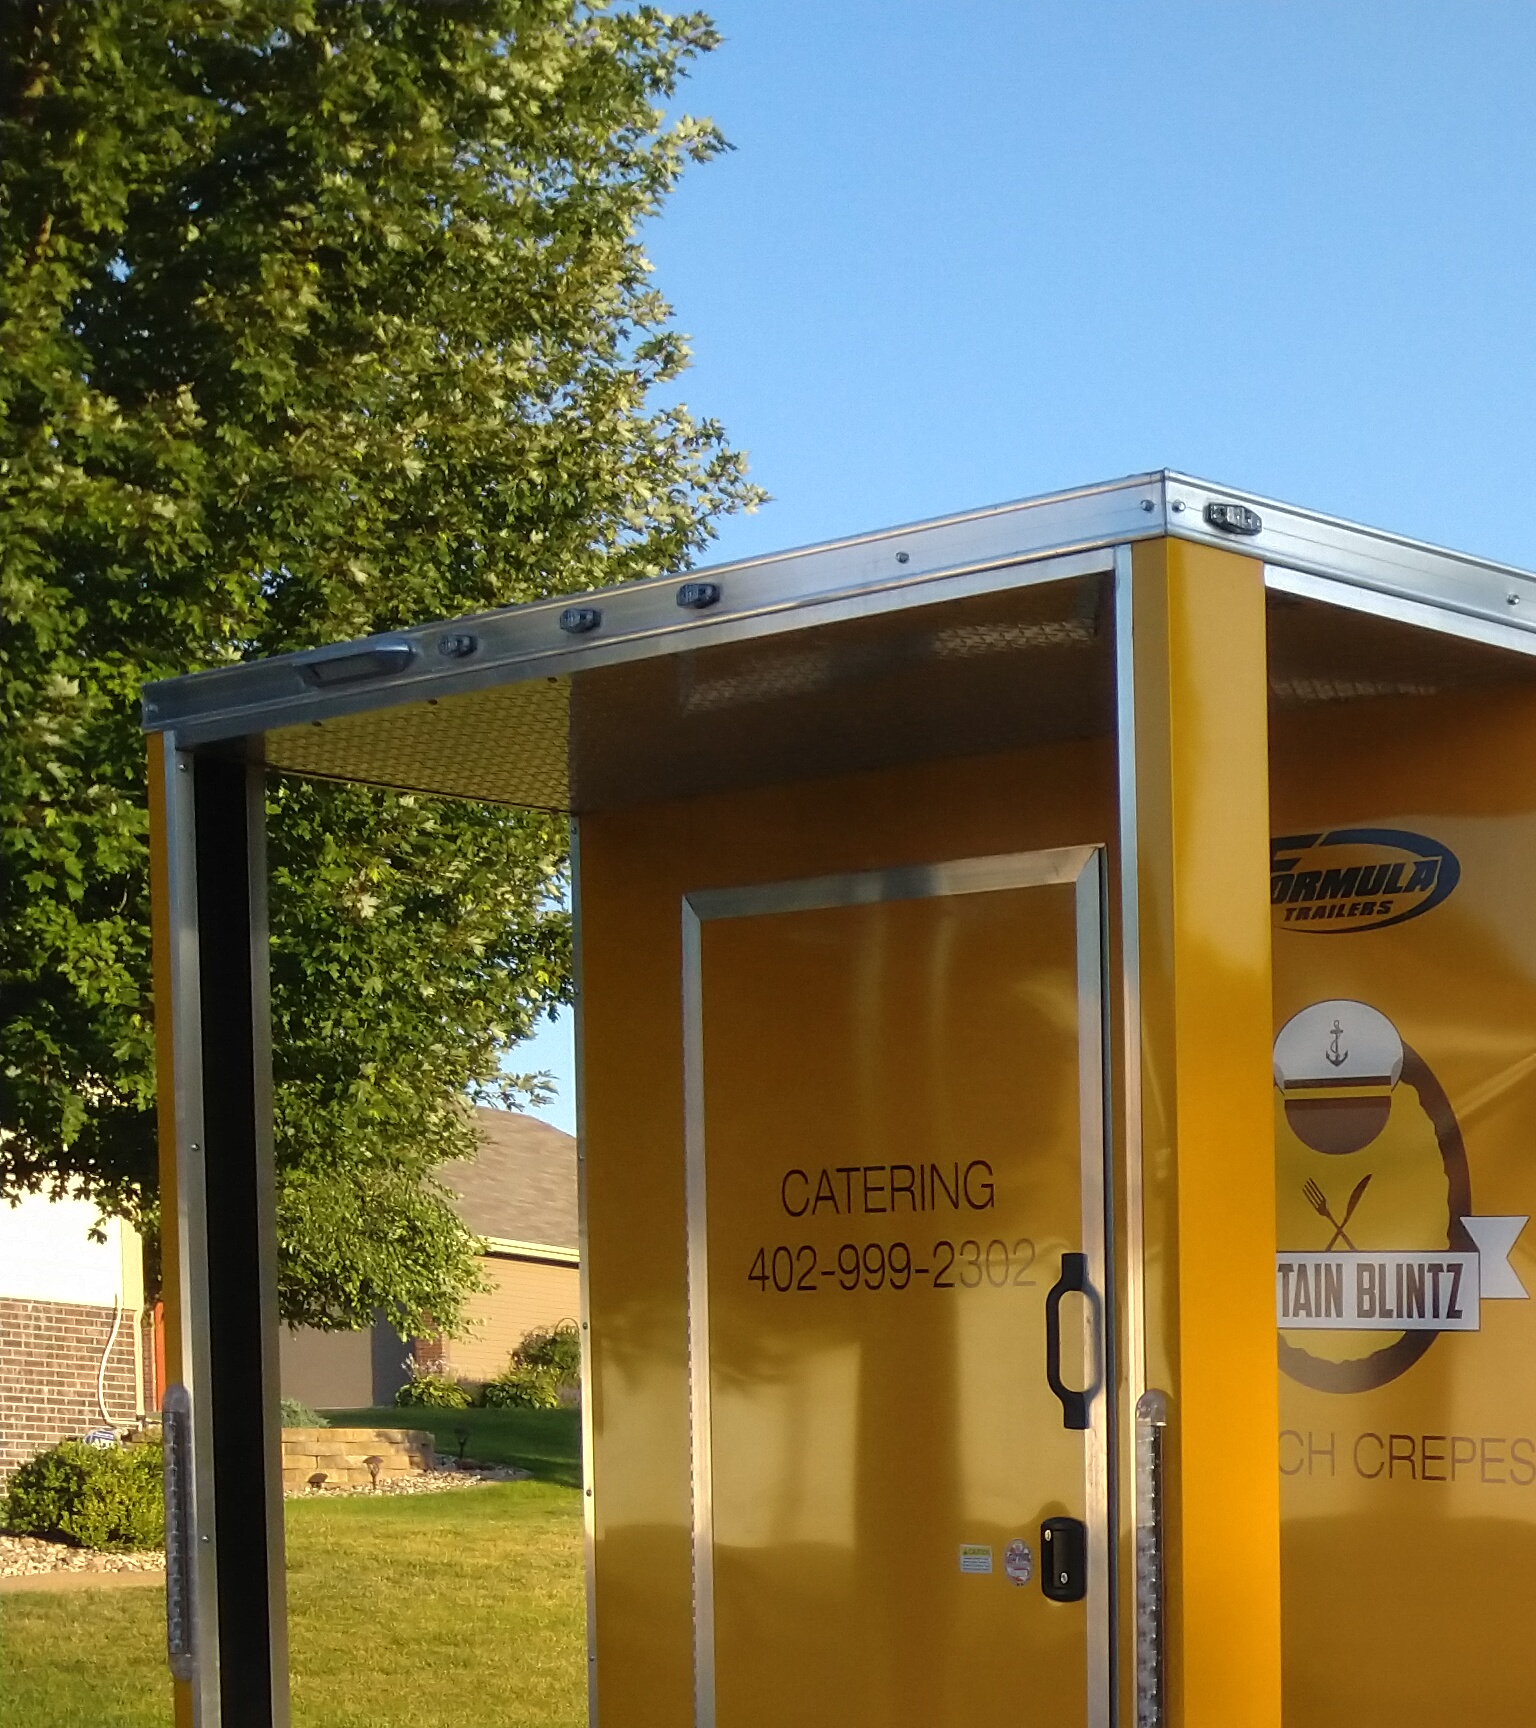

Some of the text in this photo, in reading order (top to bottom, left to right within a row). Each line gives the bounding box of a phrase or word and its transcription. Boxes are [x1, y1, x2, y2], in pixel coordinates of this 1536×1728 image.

[1284, 900, 1393, 922] TRAILERS
[782, 1160, 995, 1217] CATERING
[748, 1238, 1036, 1292] 402-999-2302
[1277, 1262, 1464, 1320] TAIN BLINTZ
[1354, 1432, 1536, 1486] CREPES
